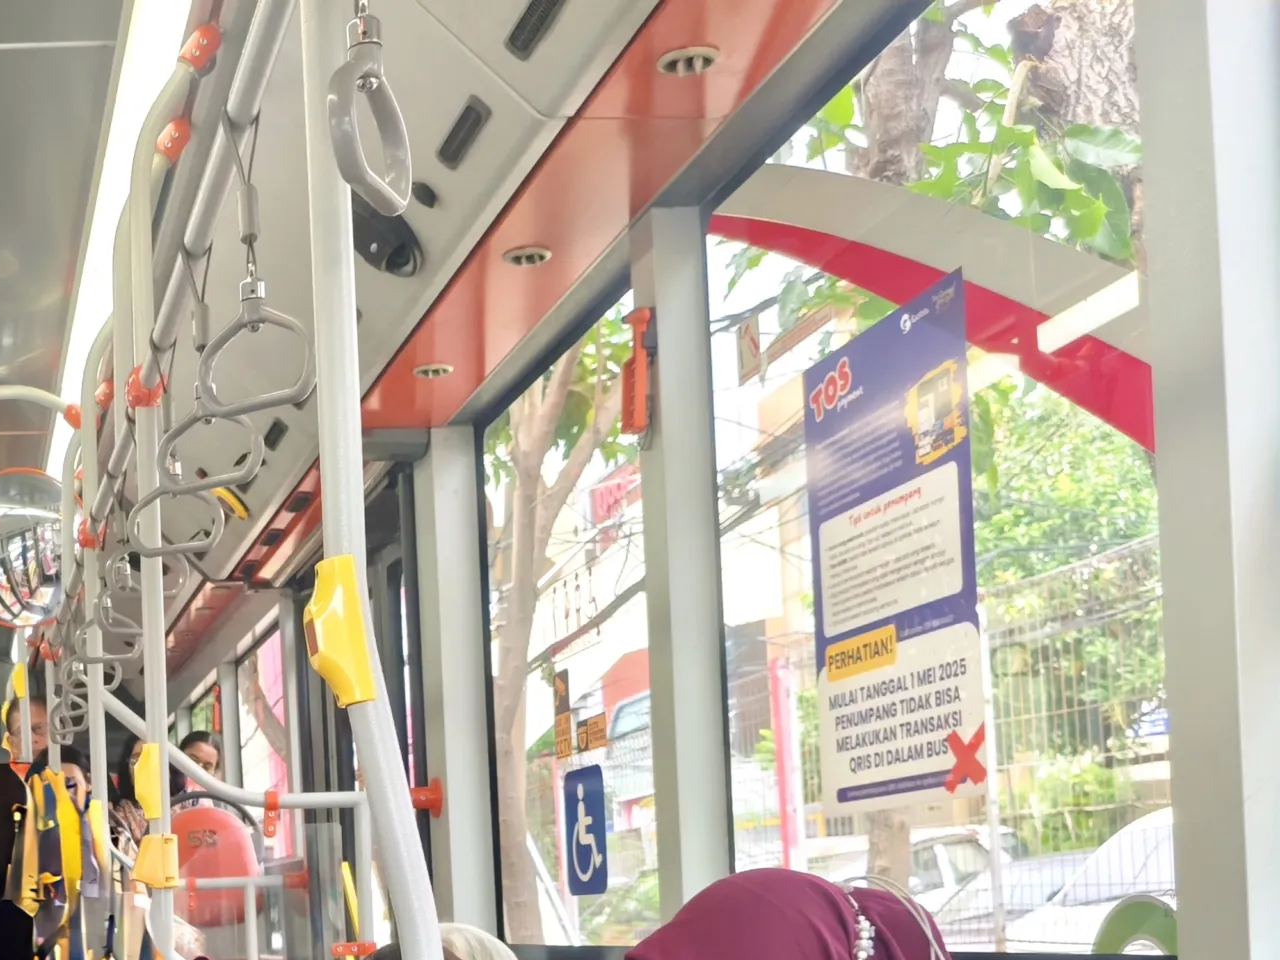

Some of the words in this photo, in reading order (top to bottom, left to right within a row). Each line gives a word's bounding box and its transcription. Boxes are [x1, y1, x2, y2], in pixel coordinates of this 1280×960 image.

[809, 356, 852, 423] TOS
[828, 635, 893, 672] PERHATIAN!
[828, 691, 858, 711] MULAI
[860, 679, 909, 703] TANGGAL
[910, 672, 916, 689] 1
[917, 668, 936, 686] MEI
[939, 658, 967, 682] 2025
[835, 703, 897, 732] PENUMPANG
[900, 695, 932, 714] TIDAK
[935, 686, 961, 707] BISA
[836, 724, 897, 753] MELAKUKAN
[899, 710, 962, 740] TRANSAKSI
[849, 754, 872, 774] QRIS
[874, 752, 884, 768] DI
[887, 741, 924, 765] DALAM
[927, 738, 948, 756] BUS
